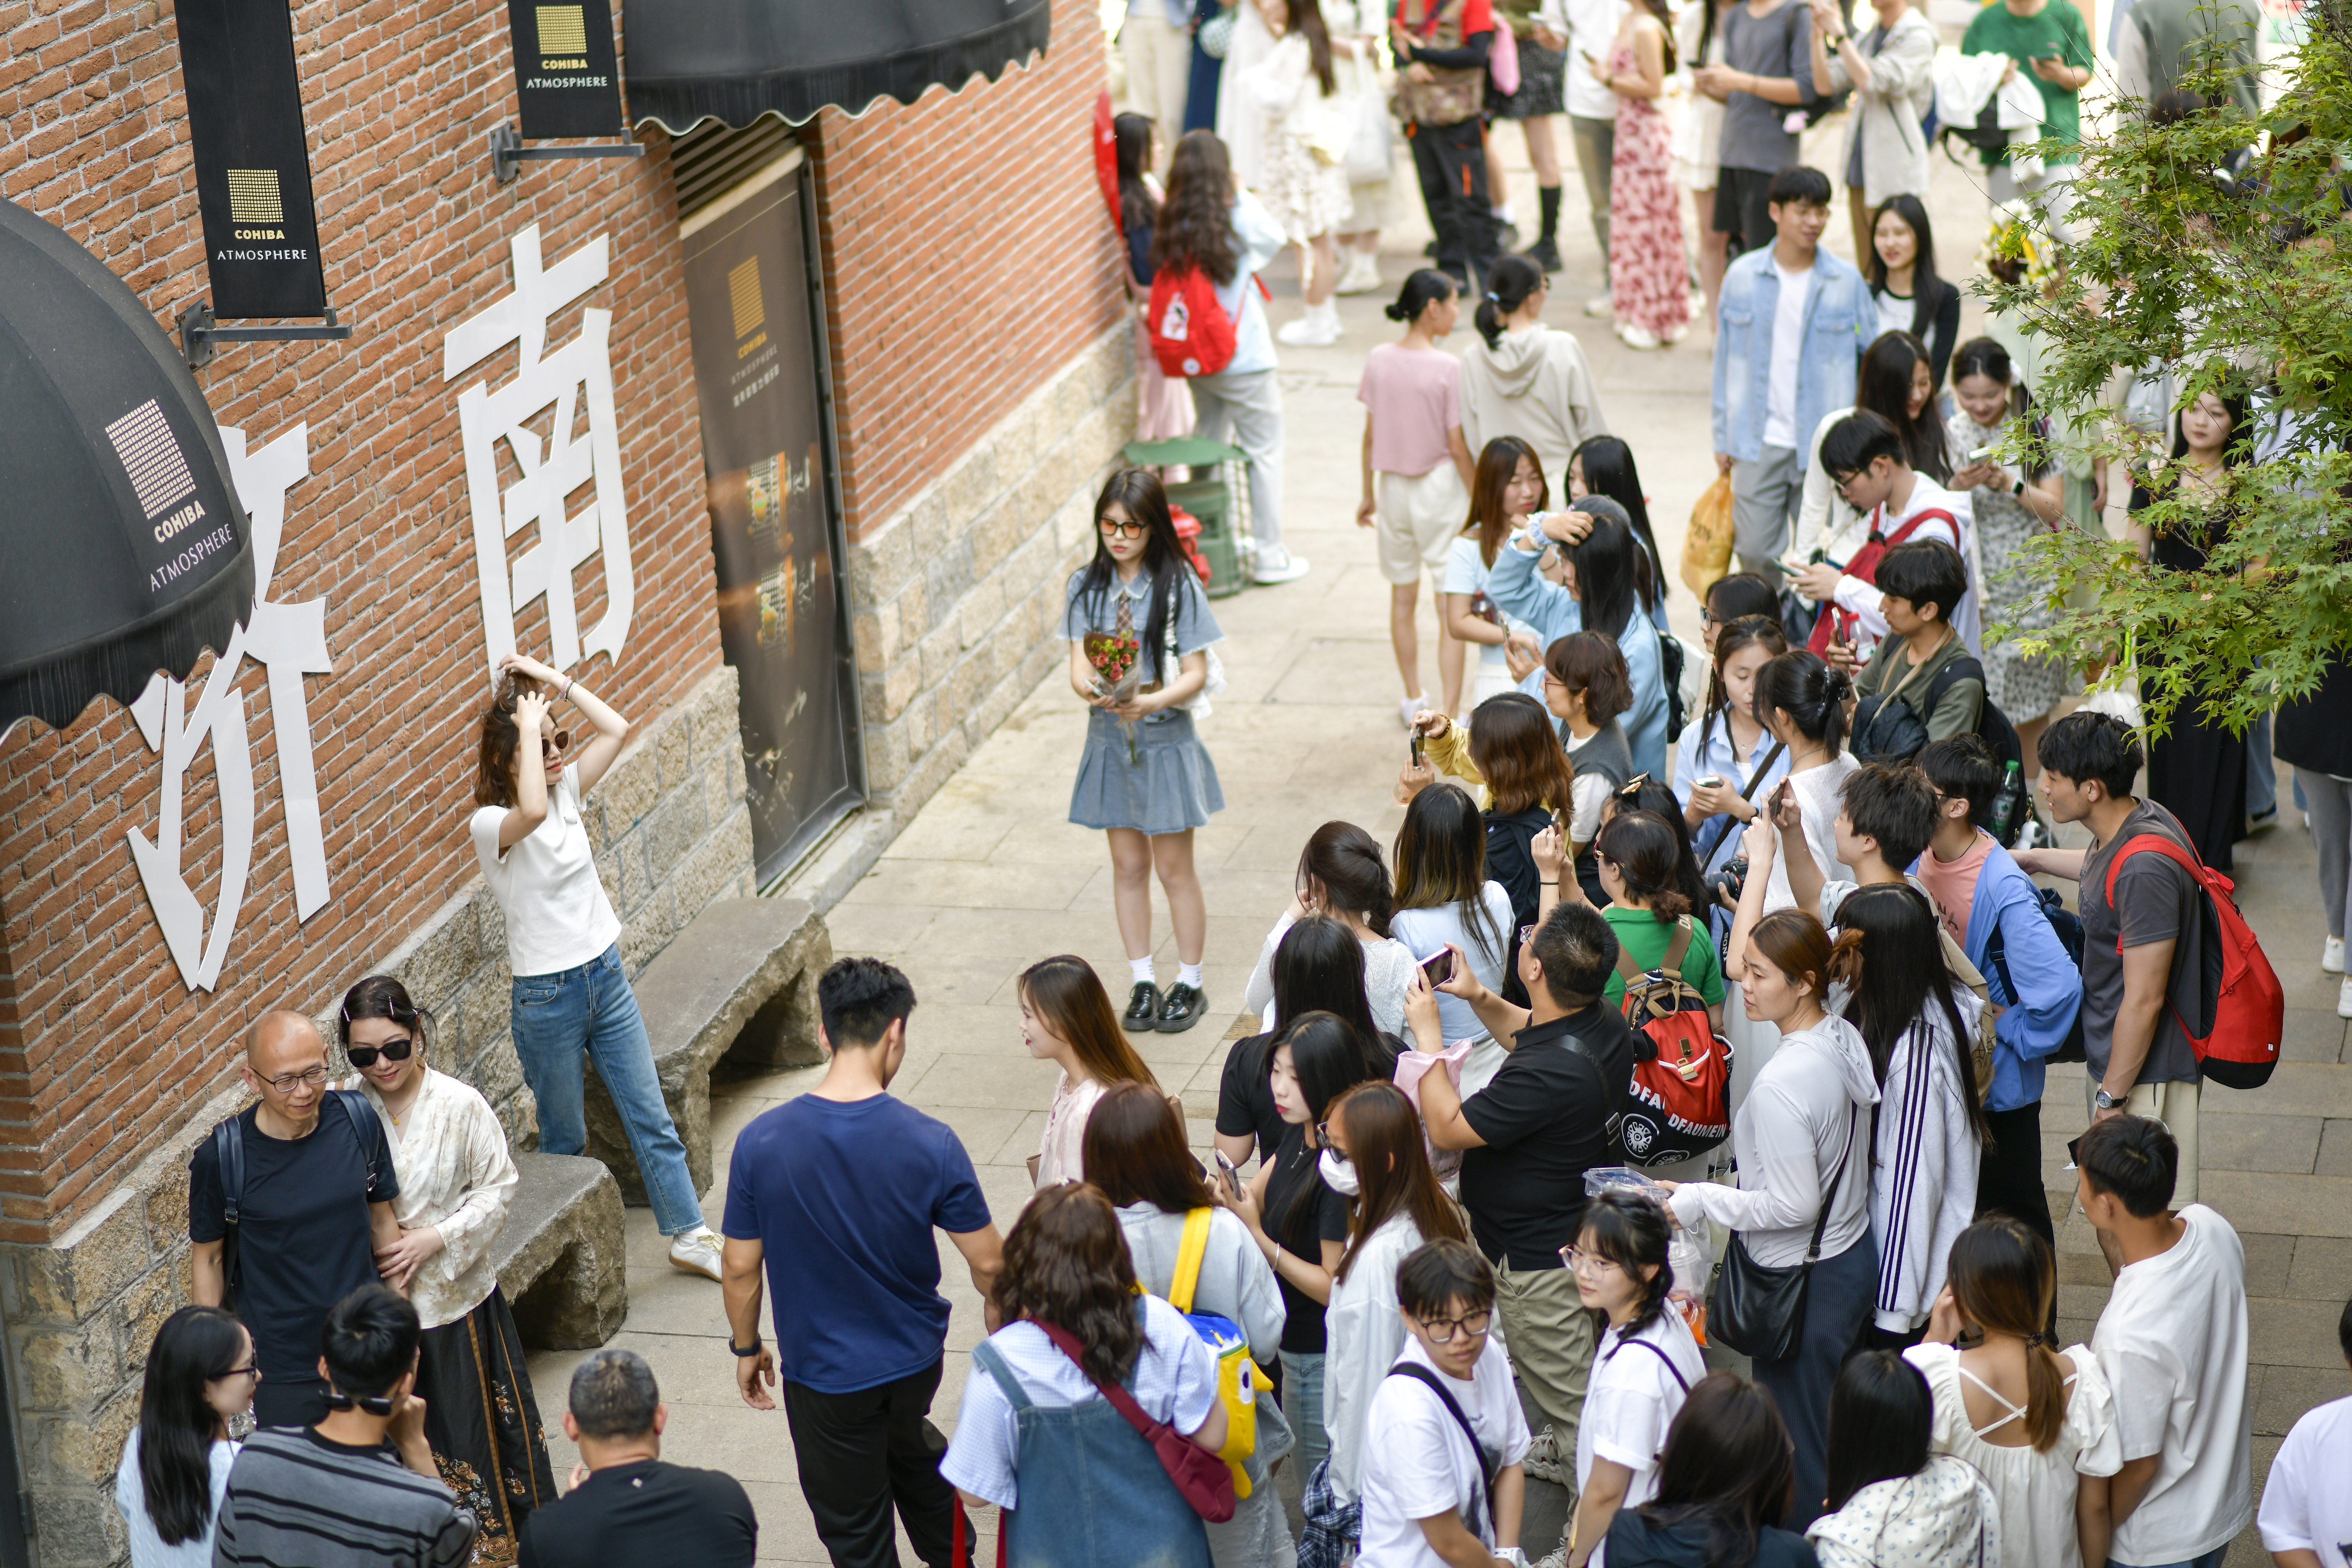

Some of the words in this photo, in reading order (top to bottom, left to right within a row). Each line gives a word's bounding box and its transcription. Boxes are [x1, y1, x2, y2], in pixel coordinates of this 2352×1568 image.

[542, 58, 588, 70] COHIBA
[526, 77, 607, 89] ATMOSPHERE
[235, 229, 285, 240] COHIBA
[218, 249, 307, 260] ATMOSPHERE
[738, 331, 767, 359] COHIBA
[154, 500, 206, 543] COHIBA
[150, 523, 232, 592] ATMOSPHERE
[1668, 1113, 1727, 1137] DFAUMEIN
